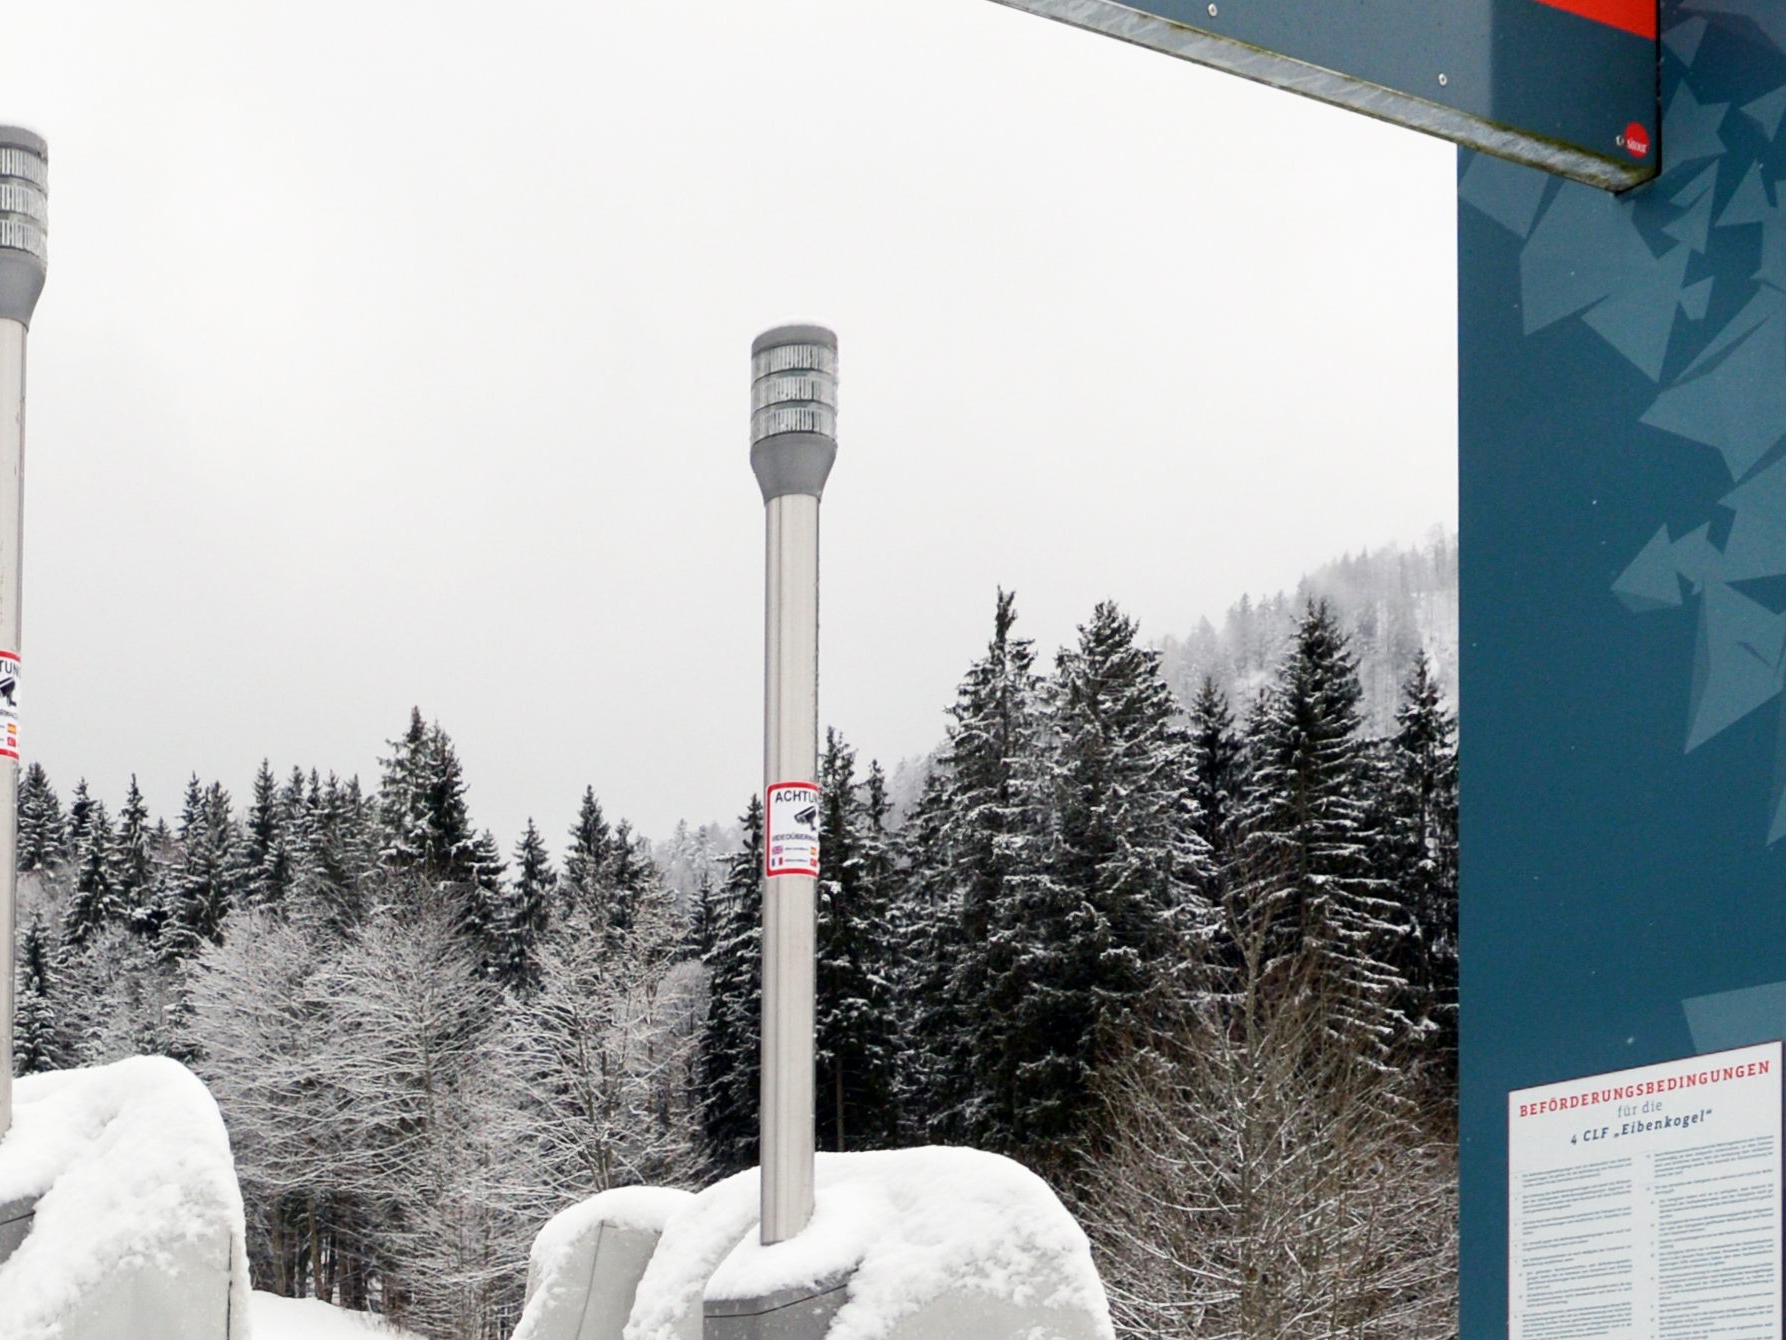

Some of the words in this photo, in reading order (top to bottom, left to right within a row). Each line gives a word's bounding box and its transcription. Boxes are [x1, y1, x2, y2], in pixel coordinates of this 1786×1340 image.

[1519, 1060, 1771, 1118] BEFÖRDERUNGSBEDINGUNGEN
[1617, 1102, 1638, 1119] für
[1641, 1100, 1663, 1115] die
[1570, 1134, 1578, 1146] 4
[1582, 1127, 1610, 1143] CLF
